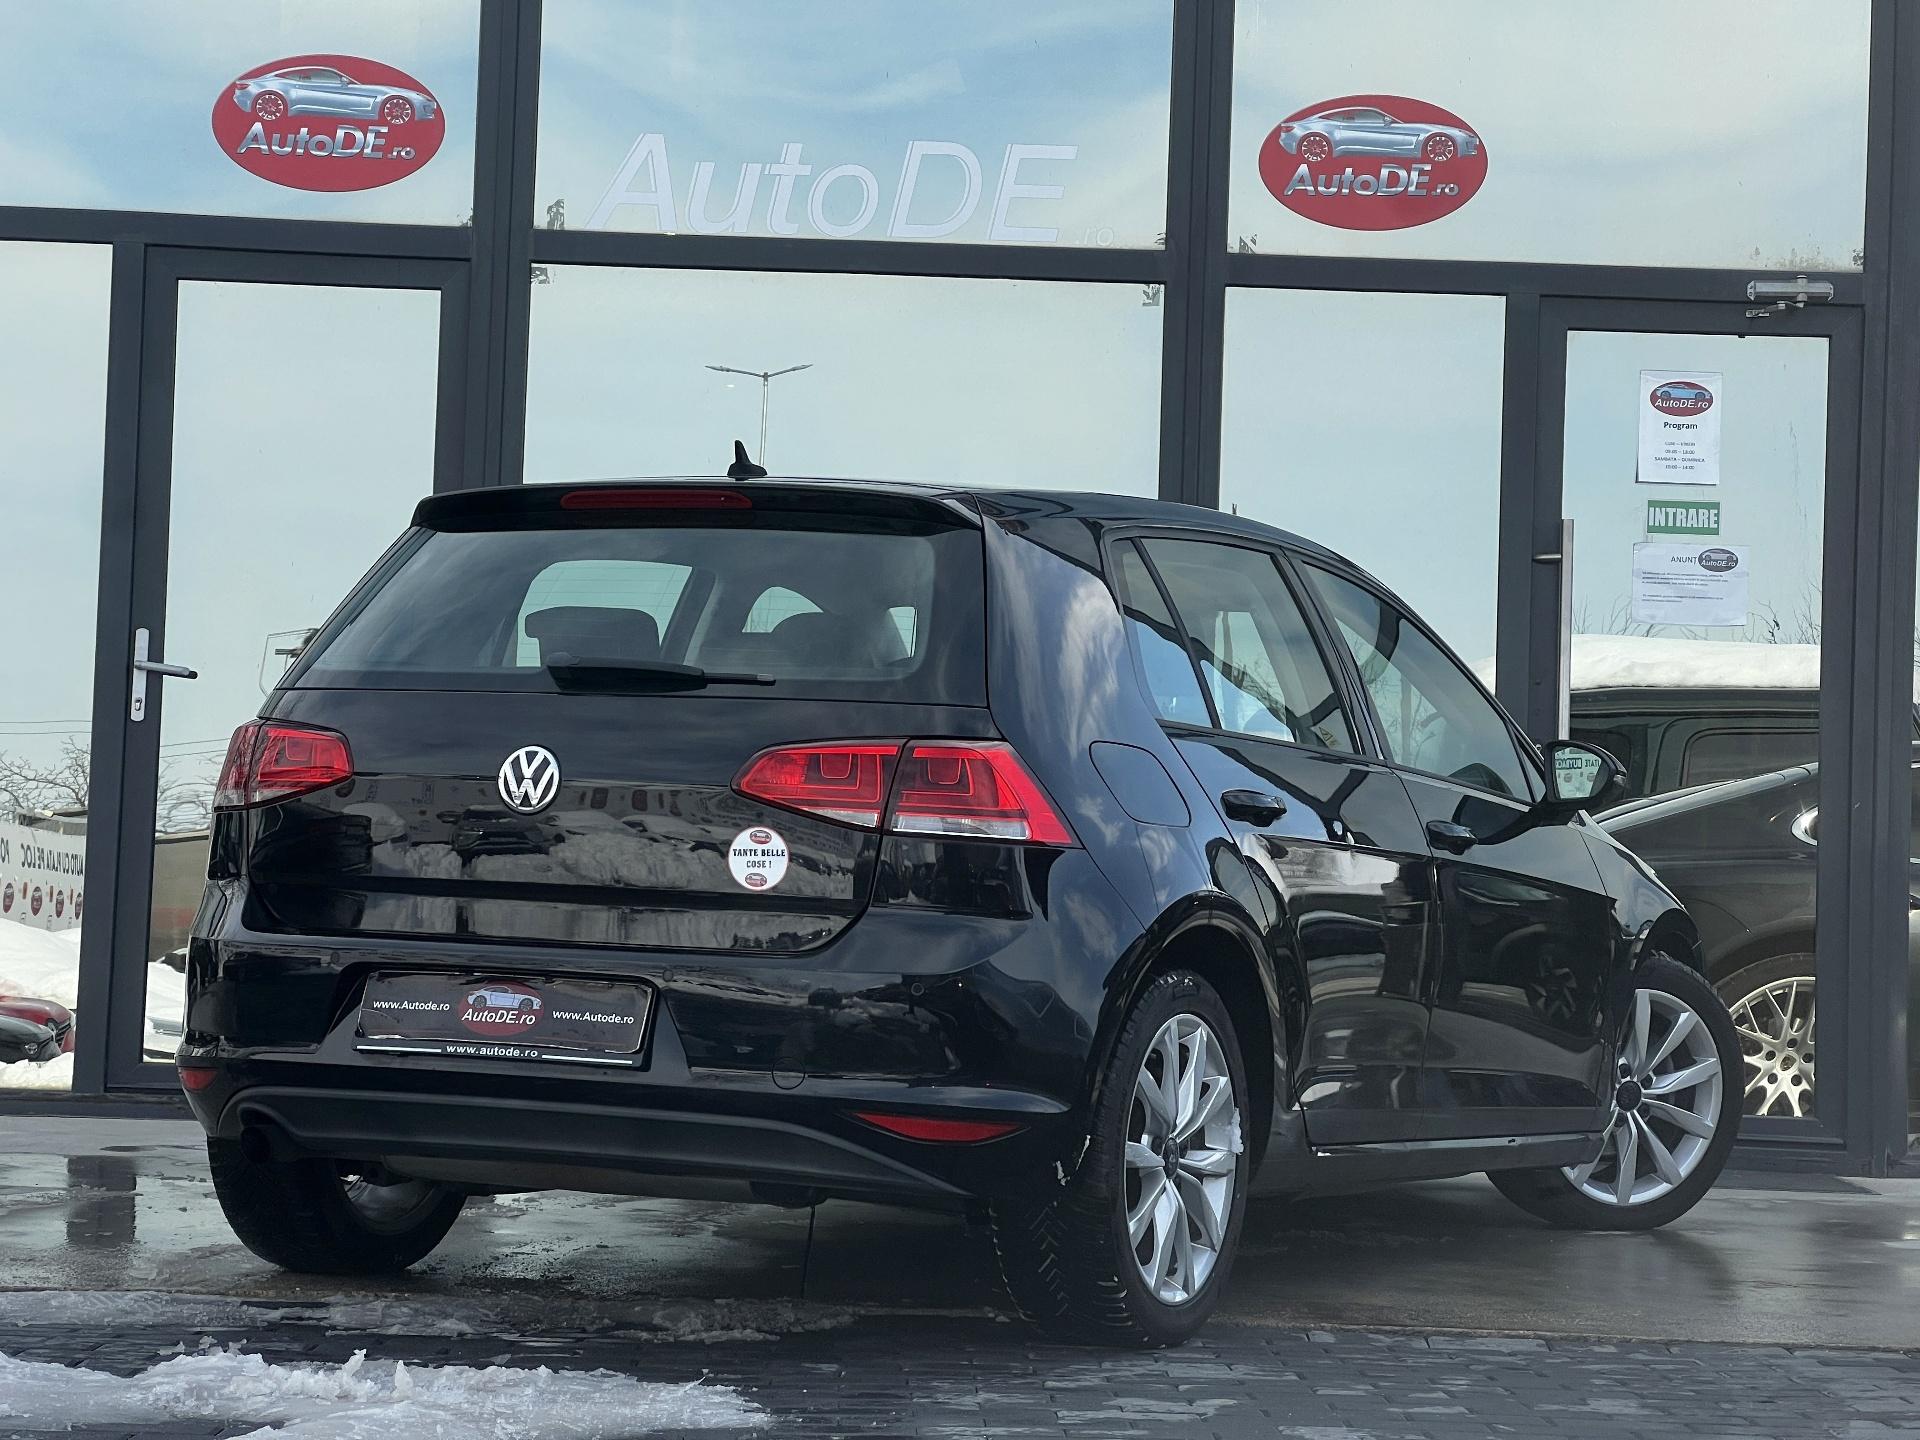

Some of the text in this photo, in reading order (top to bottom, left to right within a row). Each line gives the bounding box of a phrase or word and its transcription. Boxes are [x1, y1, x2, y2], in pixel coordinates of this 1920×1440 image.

[1655, 399, 1709, 409] AutoDE.ro
[1663, 421, 1698, 431] Program
[1648, 507, 1718, 528] INTRARE
[732, 848, 786, 857] TANTE BELLE
[746, 860, 767, 868] COSE
[373, 1000, 450, 1011] www.Autode.ro
[461, 1008, 536, 1025] AutoDE.ro
[552, 1009, 634, 1025] www.Autode.ro
[446, 1045, 538, 1058] www.autode.ro
